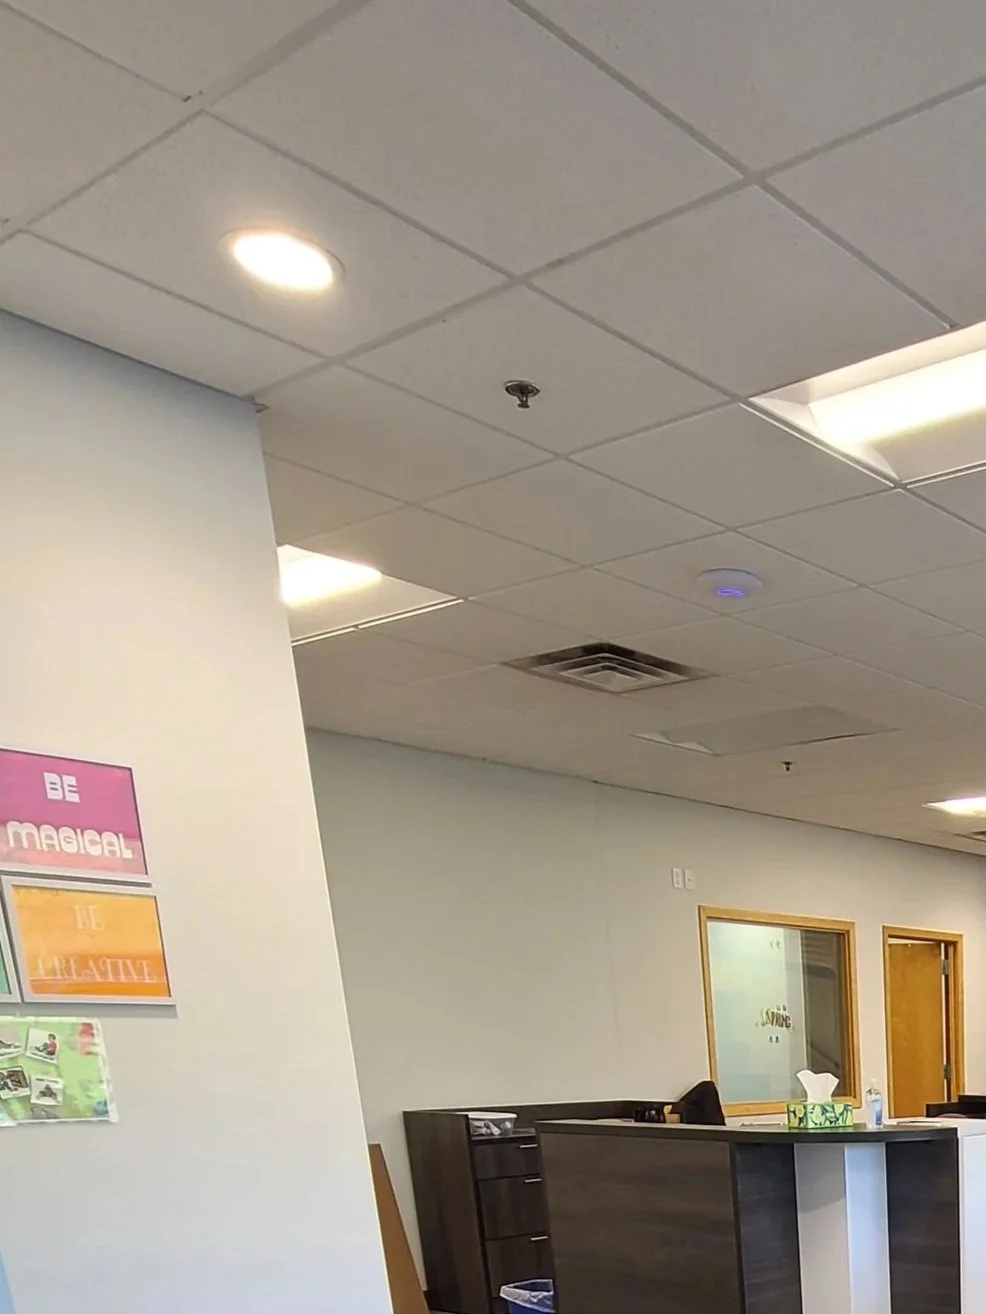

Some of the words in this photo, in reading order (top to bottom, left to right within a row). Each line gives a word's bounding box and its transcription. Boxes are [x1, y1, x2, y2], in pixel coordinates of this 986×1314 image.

[43, 771, 80, 803] BE
[6, 820, 133, 859] MAGICAL
[74, 904, 104, 930] BE
